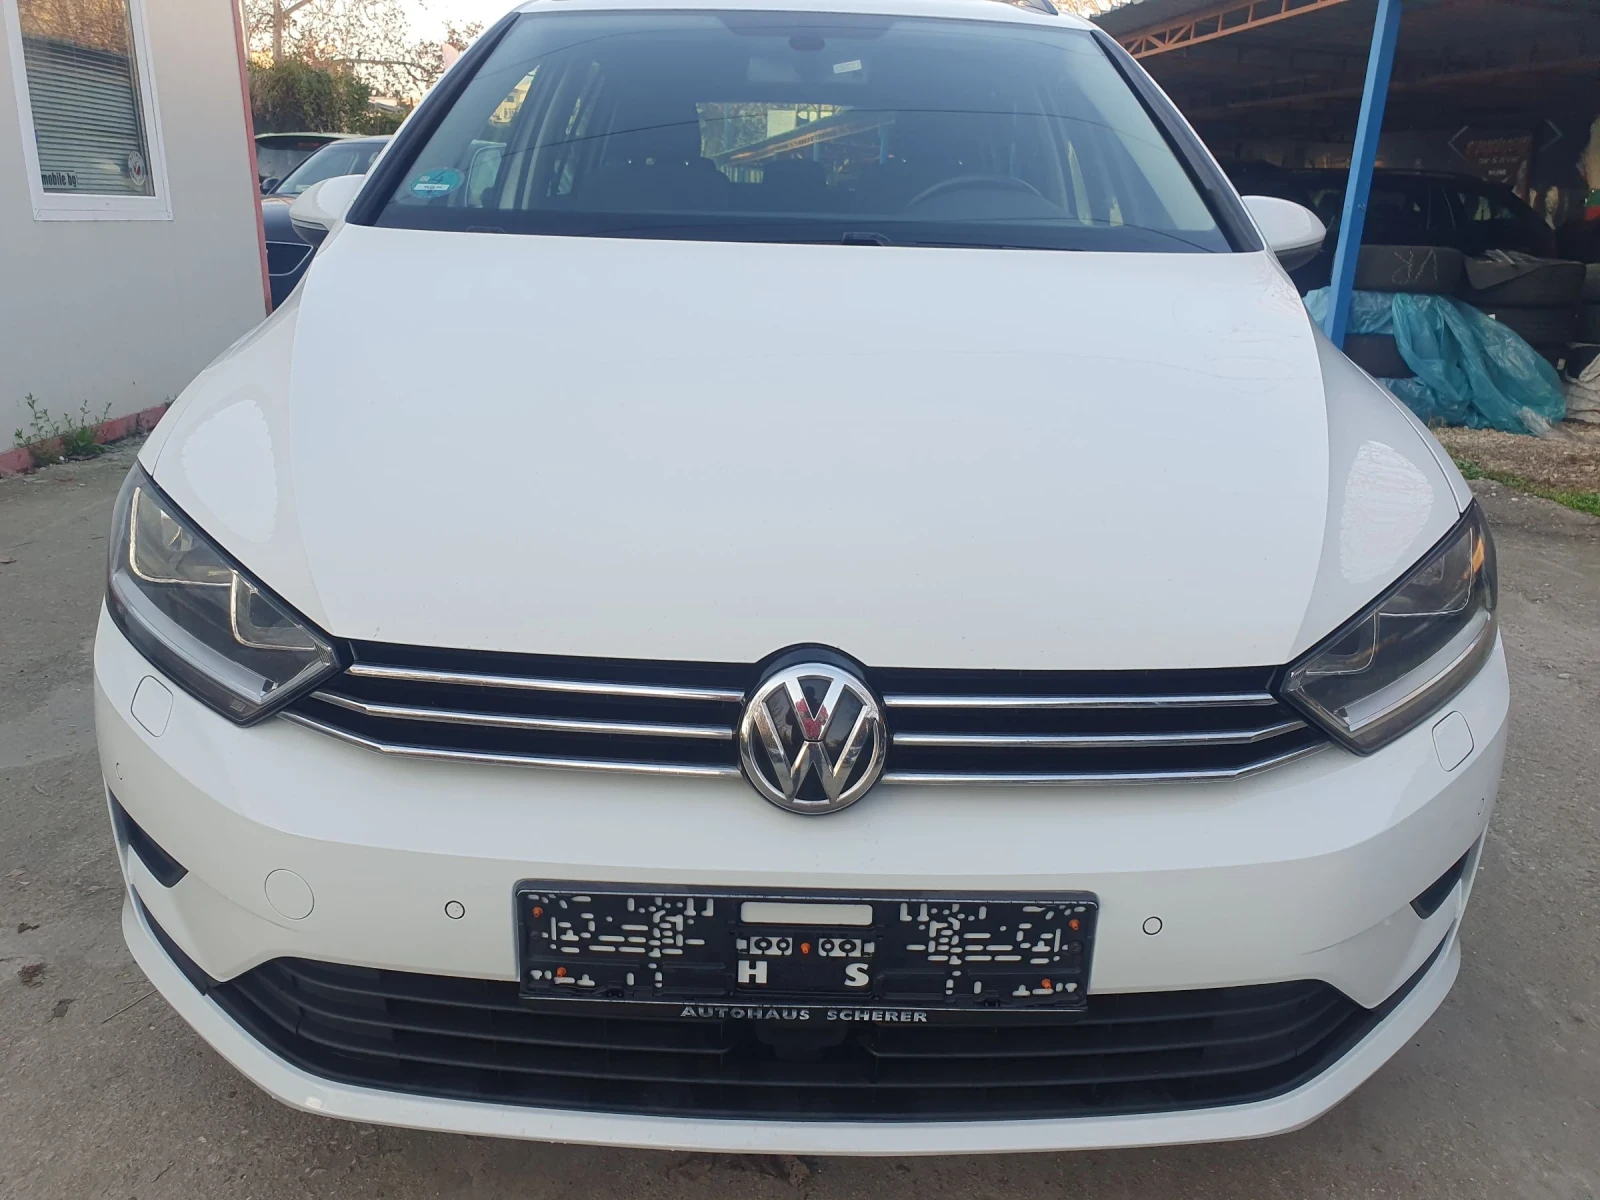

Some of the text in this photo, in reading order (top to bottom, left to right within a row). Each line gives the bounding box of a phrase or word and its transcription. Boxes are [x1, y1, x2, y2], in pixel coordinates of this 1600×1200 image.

[738, 960, 869, 987] H S
[680, 1006, 928, 1022] AUTOHAUS SCHERER
